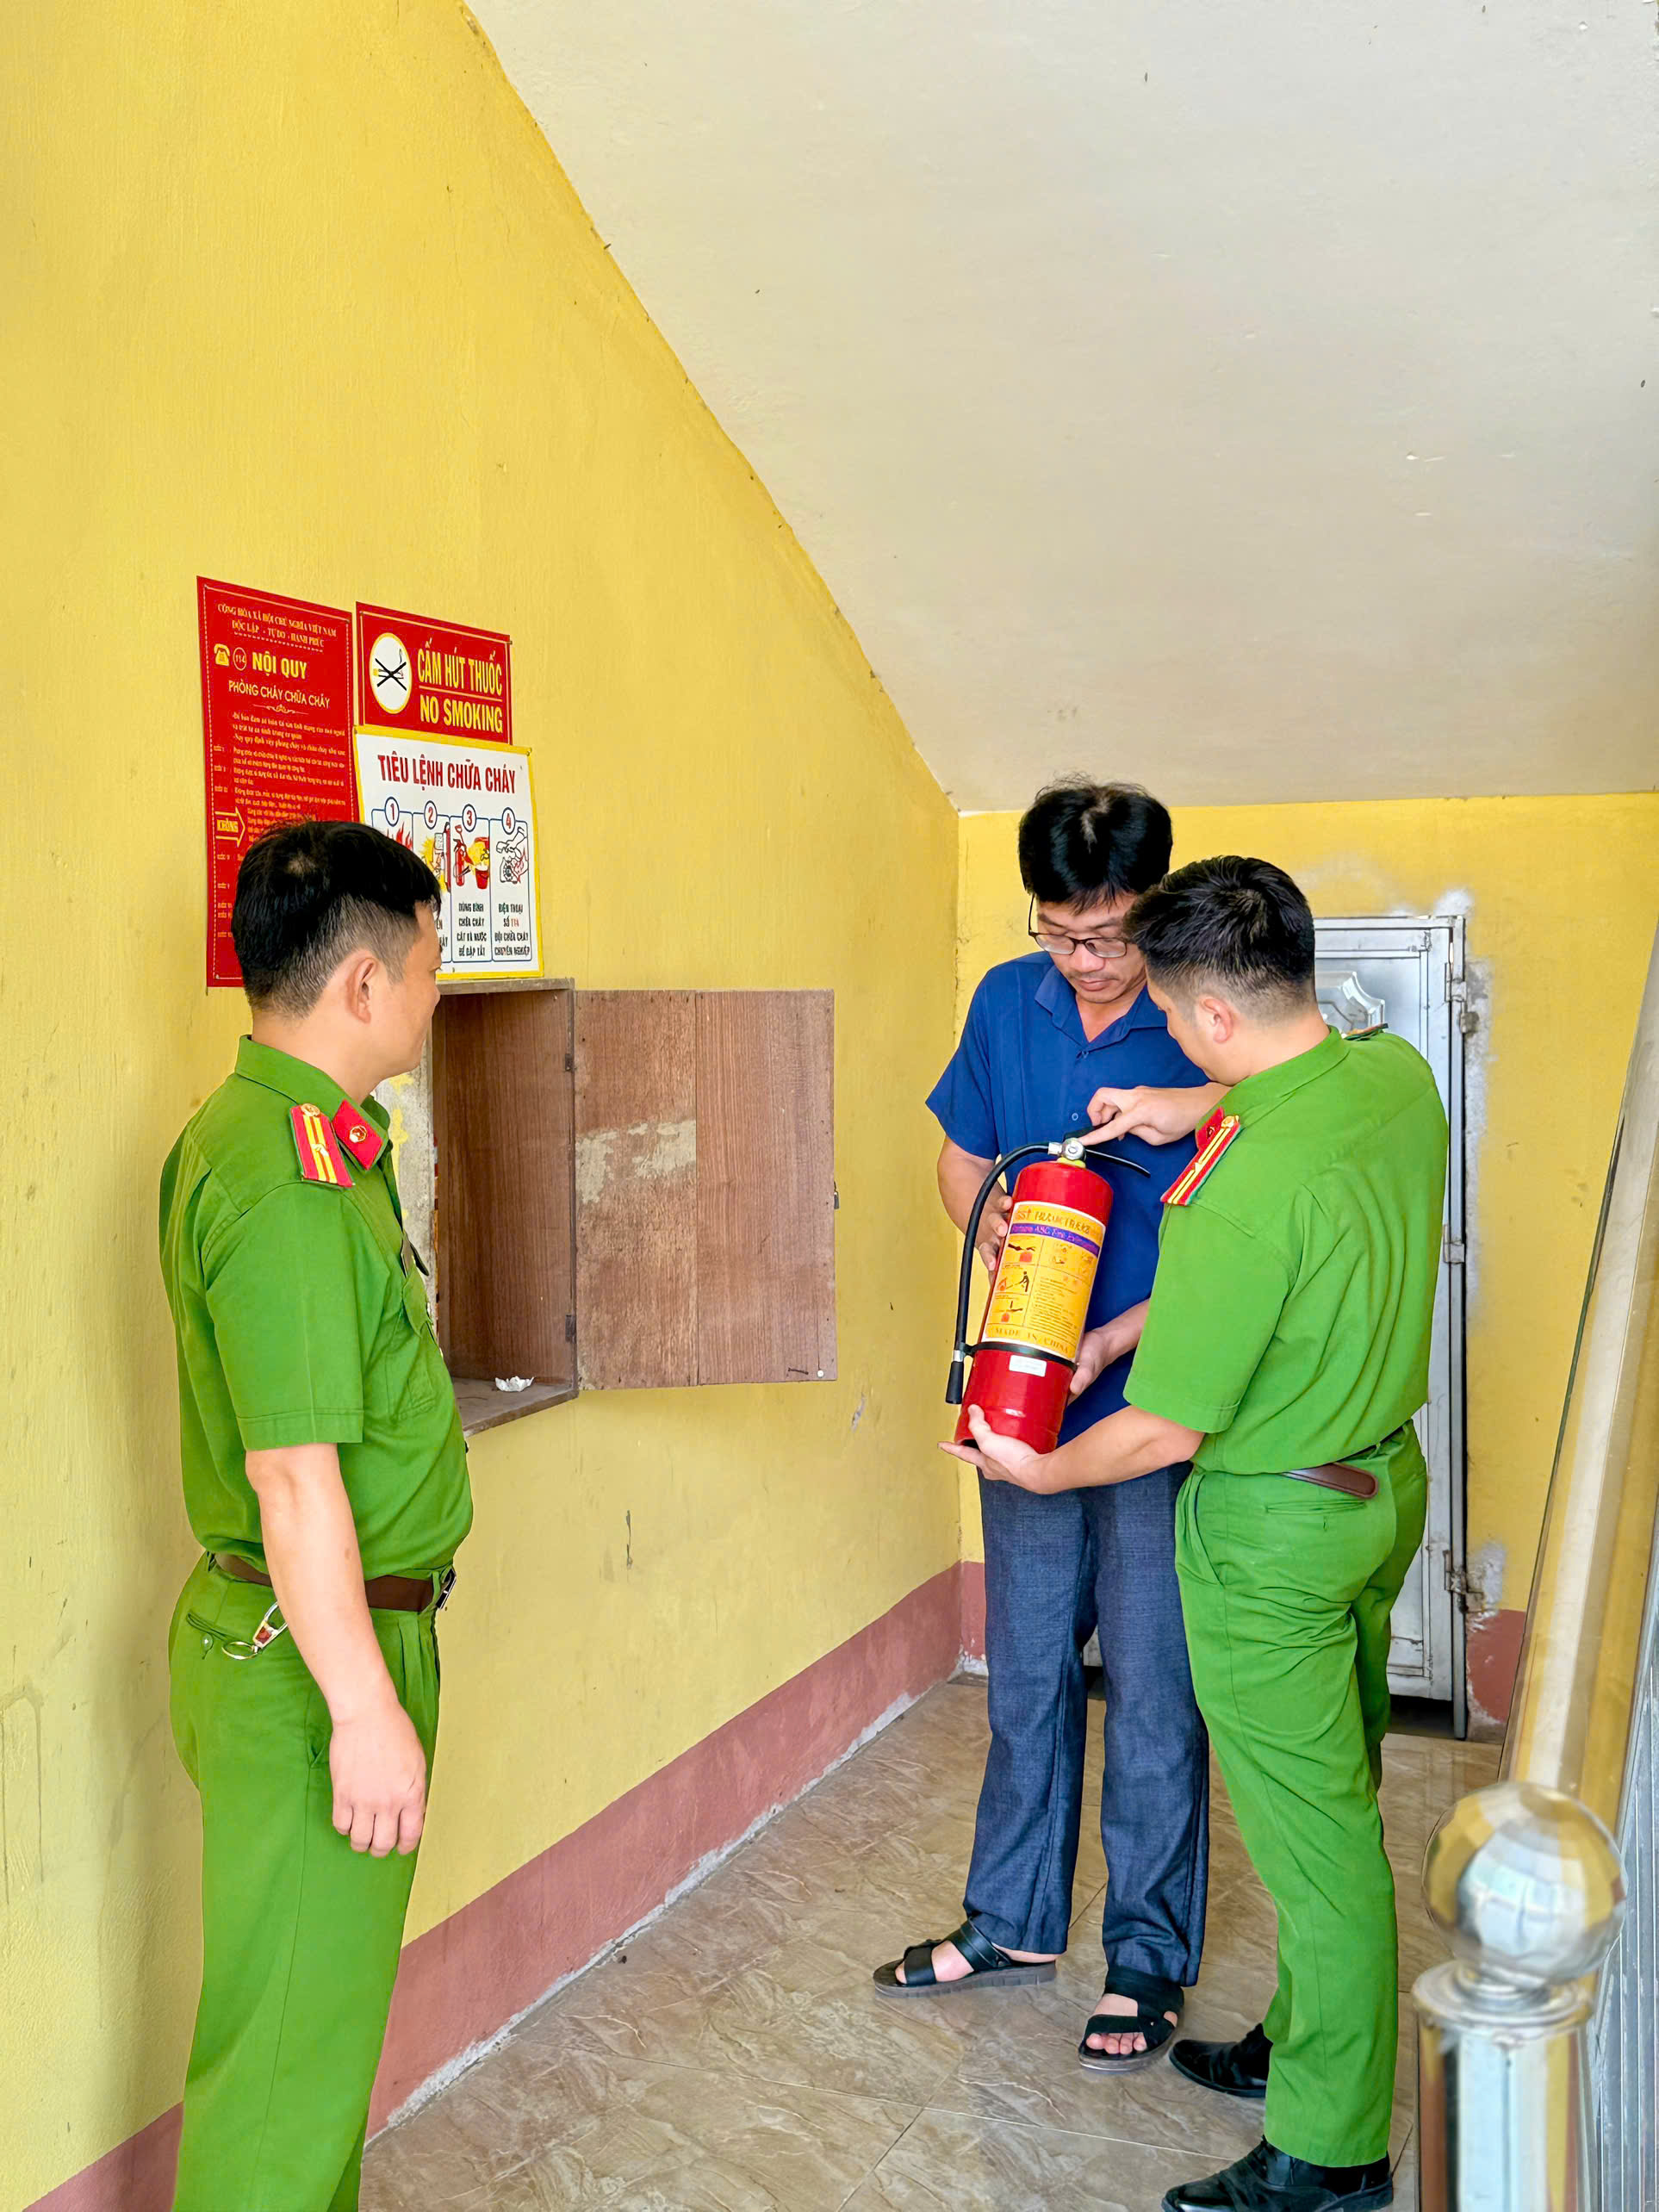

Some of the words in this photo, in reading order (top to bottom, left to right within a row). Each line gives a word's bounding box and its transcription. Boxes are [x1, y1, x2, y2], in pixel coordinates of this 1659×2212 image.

[252, 650, 276, 677] NỘI
[281, 657, 308, 680] QUY
[417, 637, 442, 686] CẤM
[444, 647, 465, 689] HÚT
[469, 650, 502, 696] THUỐC
[228, 679, 258, 696] PHÒNG
[260, 685, 283, 700] CHÁY
[284, 689, 307, 704] CHỮA
[308, 693, 330, 709] CHÁY
[419, 694, 439, 724] NO
[443, 698, 503, 733] SMOKING
[377, 750, 409, 783] TIÊU
[413, 754, 444, 791] LỆNH
[447, 758, 482, 791] CHỮA
[485, 763, 516, 794] CHÁY
[390, 803, 395, 821] 1
[428, 806, 433, 823] 2
[467, 810, 473, 827] 3
[506, 813, 512, 830] 4
[995, 1327, 1020, 1337] MADE
[1044, 1336, 1069, 1354] CHINA
